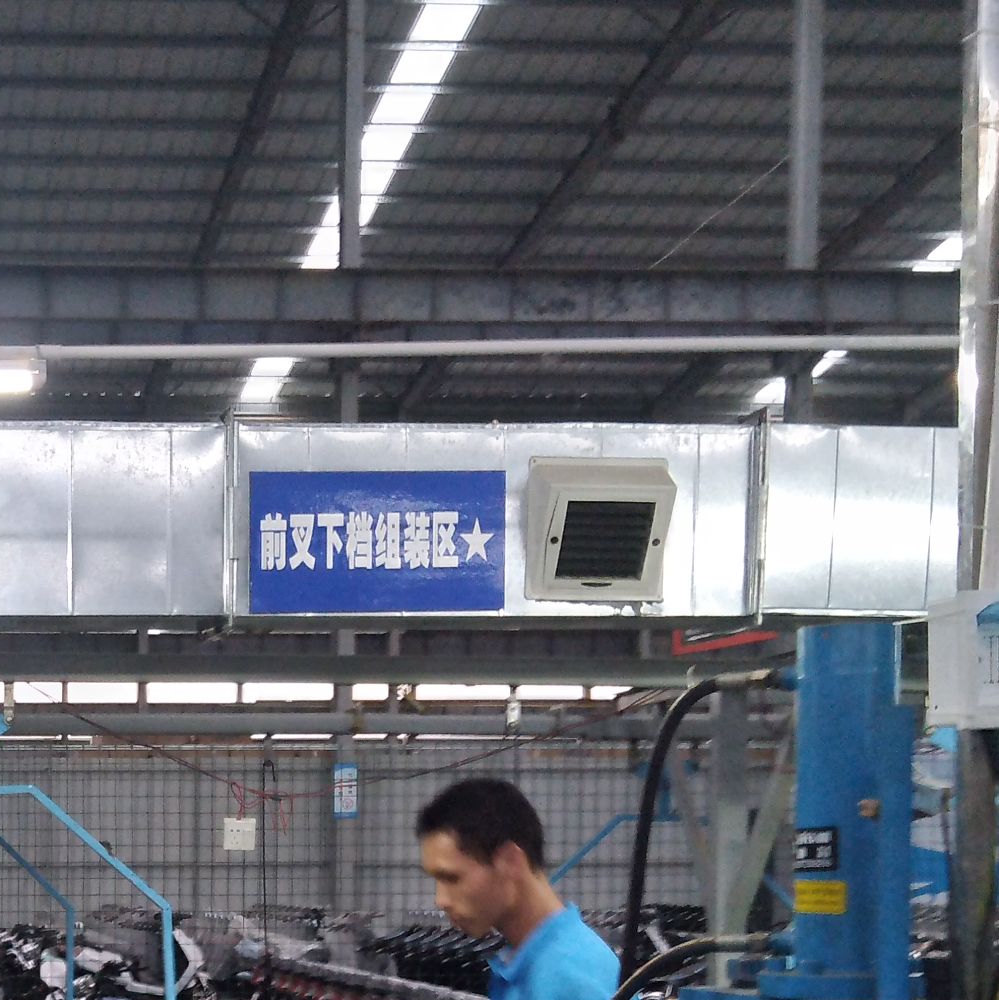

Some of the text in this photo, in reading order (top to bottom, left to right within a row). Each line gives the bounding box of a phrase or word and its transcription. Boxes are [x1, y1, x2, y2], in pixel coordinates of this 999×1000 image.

[259, 511, 459, 571] 前叉下档组装区
